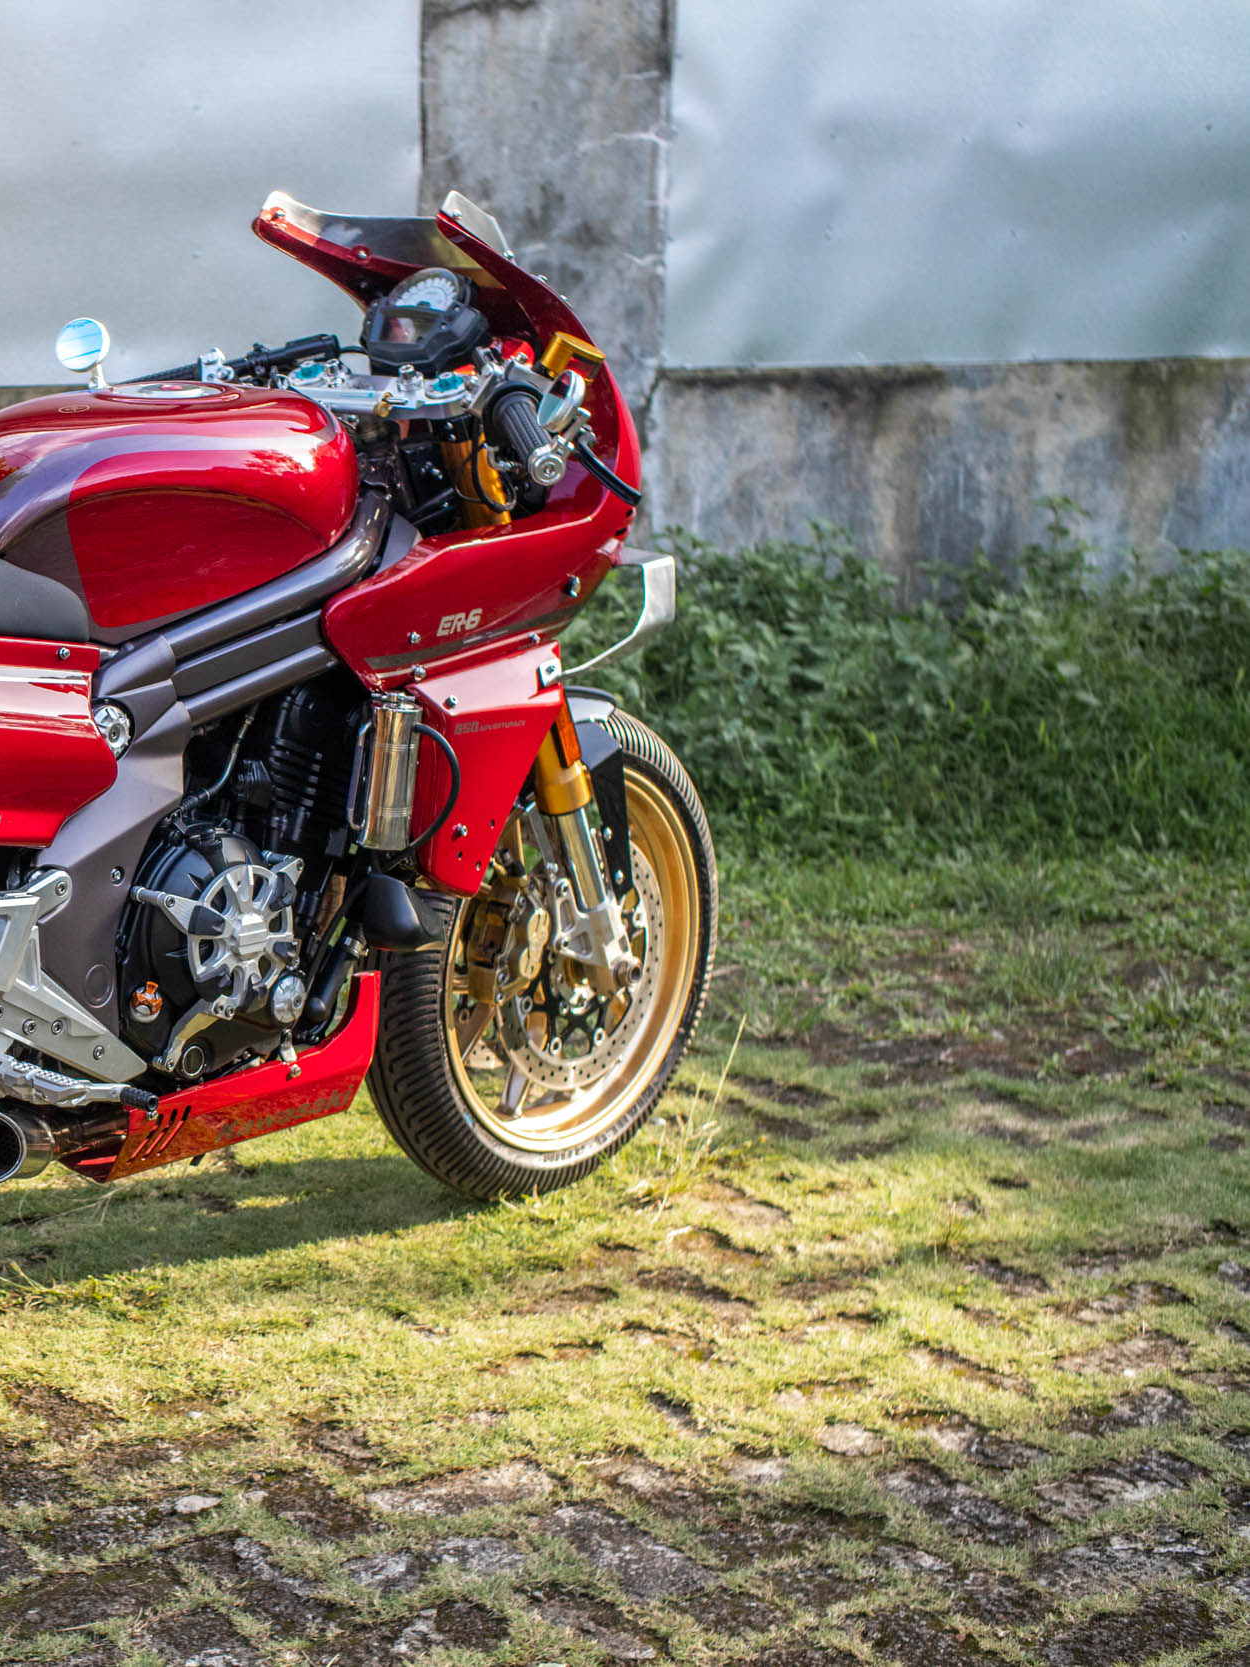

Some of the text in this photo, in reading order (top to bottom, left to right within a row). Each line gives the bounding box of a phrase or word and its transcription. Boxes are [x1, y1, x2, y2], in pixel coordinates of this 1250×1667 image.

[436, 607, 483, 637] ER-6
[453, 720, 480, 735] 650
[214, 1083, 355, 1144] Kawasaki
